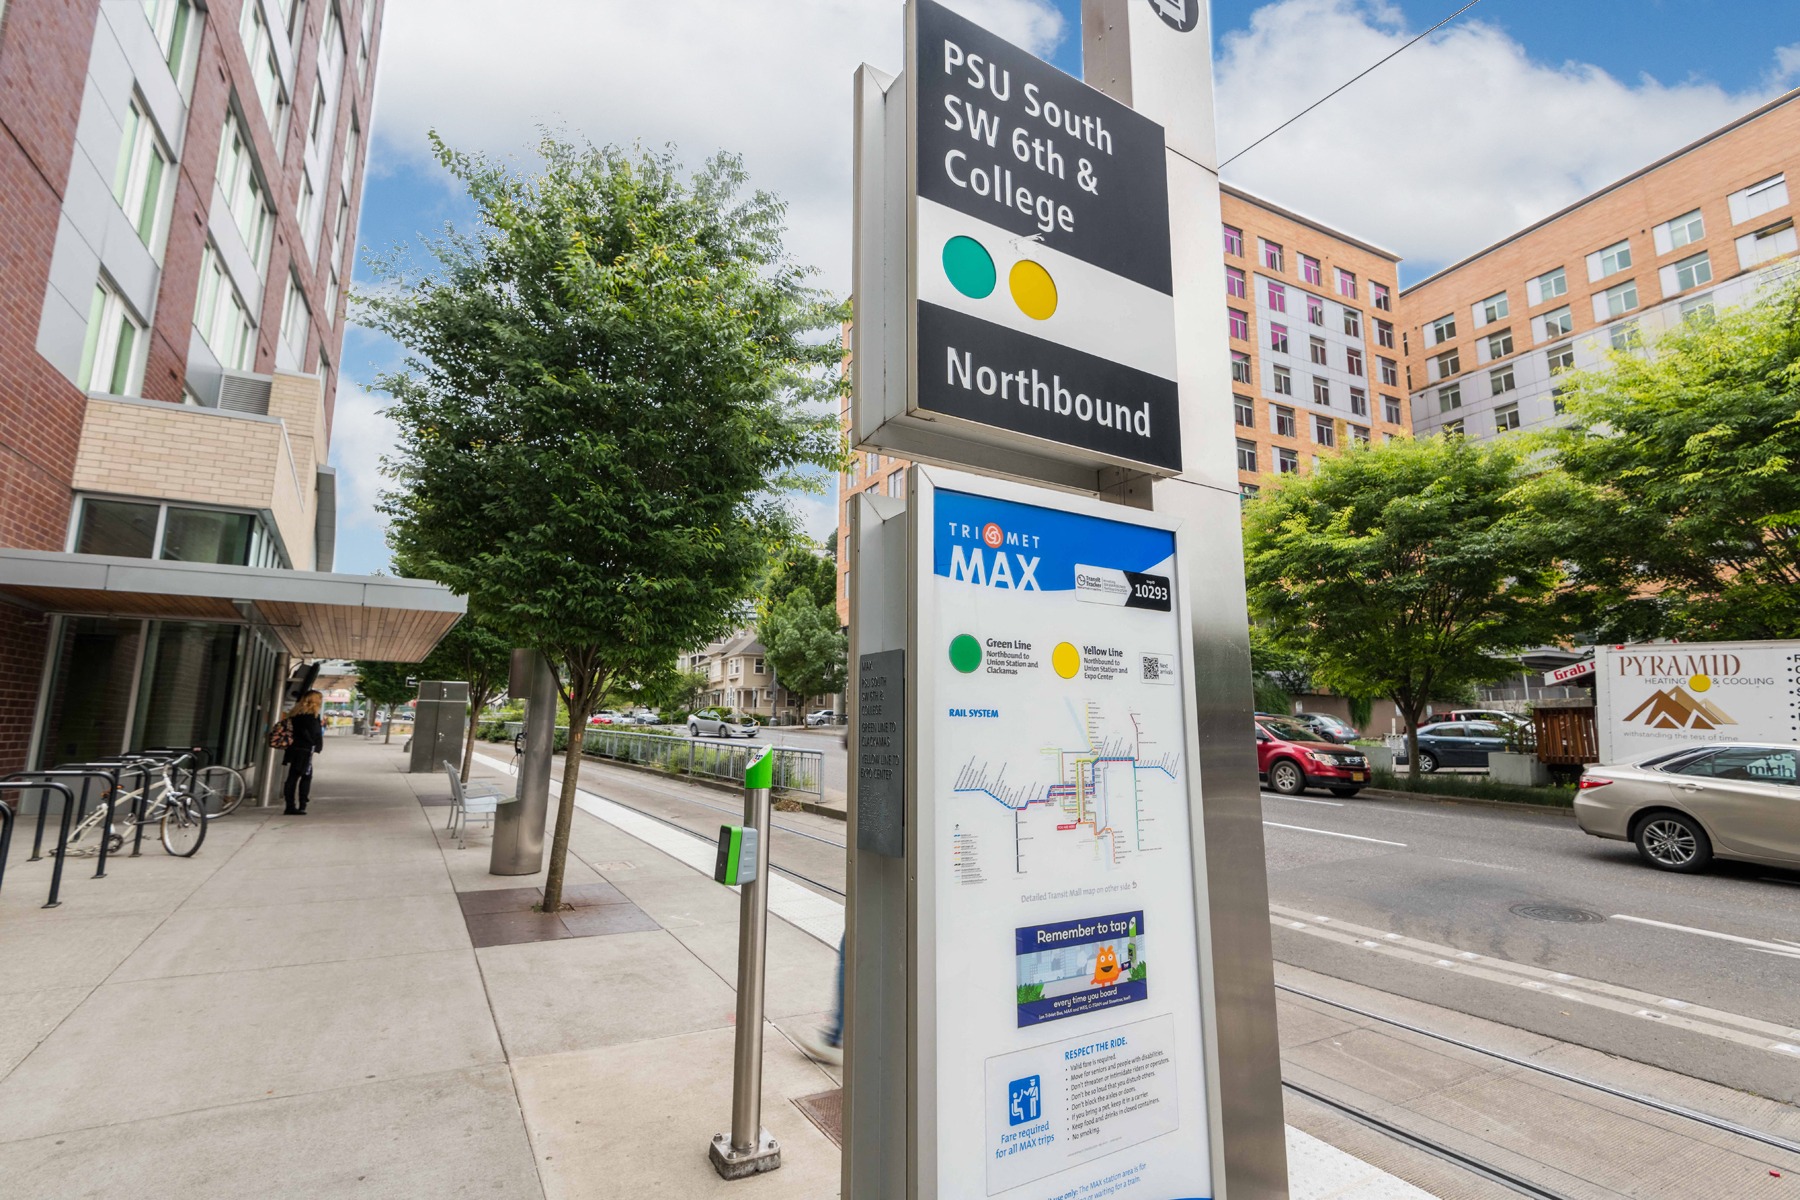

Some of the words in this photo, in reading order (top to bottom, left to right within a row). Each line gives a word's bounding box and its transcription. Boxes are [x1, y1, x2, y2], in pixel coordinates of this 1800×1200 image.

[944, 39, 1010, 102] PSU
[1024, 83, 1112, 155] South
[944, 94, 1000, 148] SW
[1012, 127, 1064, 179] 6th
[1077, 158, 1099, 196] &
[944, 149, 1075, 233] College
[946, 346, 1151, 438] Northbound
[949, 522, 979, 540] TRI
[1006, 532, 1040, 549] MET
[950, 544, 1042, 592] MAX
[1134, 584, 1168, 601] 10293
[986, 638, 1012, 649] Green
[1014, 640, 1032, 650] Line
[986, 650, 1022, 660] Northbound
[1083, 646, 1107, 656] Yellow
[1108, 648, 1123, 657] Line
[986, 667, 1018, 675] Clackamas
[1084, 658, 1114, 666] Northbound
[1554, 664, 1586, 680] Grab
[1618, 654, 1741, 676] PYRAMID
[1084, 672, 1096, 680] Expo
[949, 708, 968, 717] RAIL
[968, 709, 999, 718] SYSTEM
[1623, 731, 1673, 740] withstanding
[1021, 893, 1047, 903] Detailed
[1048, 891, 1068, 900] Transit
[1069, 888, 1082, 896] Mall
[1105, 884, 1119, 892] other
[1037, 924, 1096, 944] Remember
[1096, 922, 1108, 934] to
[1110, 920, 1128, 934] tap
[1053, 999, 1072, 1008] every
[1072, 996, 1087, 1004] time
[1087, 994, 1099, 1003] you
[1100, 986, 1118, 998] board
[1064, 1044, 1094, 1060] RESPECT
[1095, 1041, 1109, 1052] THE
[1110, 1037, 1128, 1049] RIDE.
[1070, 1062, 1082, 1071] Valid
[1097, 1054, 1116, 1064] required.
[1091, 1066, 1107, 1075] seniors
[1108, 1063, 1116, 1072] and
[1117, 1059, 1131, 1070] people
[1131, 1056, 1141, 1064] with
[1142, 1050, 1164, 1061] disabilities.
[1071, 1082, 1084, 1091] Don't
[1084, 1077, 1104, 1087] threaten
[1110, 1069, 1132, 1079] intimidate
[1150, 1057, 1170, 1068] operators.
[1071, 1091, 1084, 1101] Don't
[1097, 1084, 1107, 1093] loud
[1108, 1082, 1117, 1090] that
[1117, 1080, 1126, 1088] you
[1126, 1074, 1141, 1084] disturb
[1142, 1071, 1156, 1080] others.
[1071, 1101, 1085, 1111] Don't
[1085, 1097, 1097, 1107] block
[1097, 1095, 1105, 1103] the
[1106, 1091, 1118, 1100] aisles
[1124, 1086, 1136, 1095] doors.
[1072, 1122, 1084, 1131] Keep
[1084, 1118, 1095, 1127] food
[1095, 1115, 1104, 1123] and
[1105, 1111, 1118, 1120] drinks
[1124, 1103, 1137, 1113] closed
[1138, 1098, 1160, 1109] containers.
[1076, 1111, 1085, 1121] you
[1085, 1107, 1098, 1117] bring
[1110, 1100, 1122, 1110] keep
[1001, 1133, 1017, 1144] Fare
[1018, 1120, 1050, 1138] required
[1080, 1126, 1100, 1138] smoking.
[995, 1148, 1007, 1159] for
[1008, 1143, 1018, 1155] all
[1019, 1138, 1037, 1152] MAX
[1038, 1134, 1055, 1146] trips
[1064, 1189, 1078, 1199] only:
[1079, 1185, 1088, 1194] The
[1090, 1180, 1102, 1190] MAX
[1103, 1173, 1121, 1184] station
[1122, 1168, 1133, 1177] area
[1094, 1186, 1114, 1198] waiting
[1127, 1176, 1141, 1185] train.
